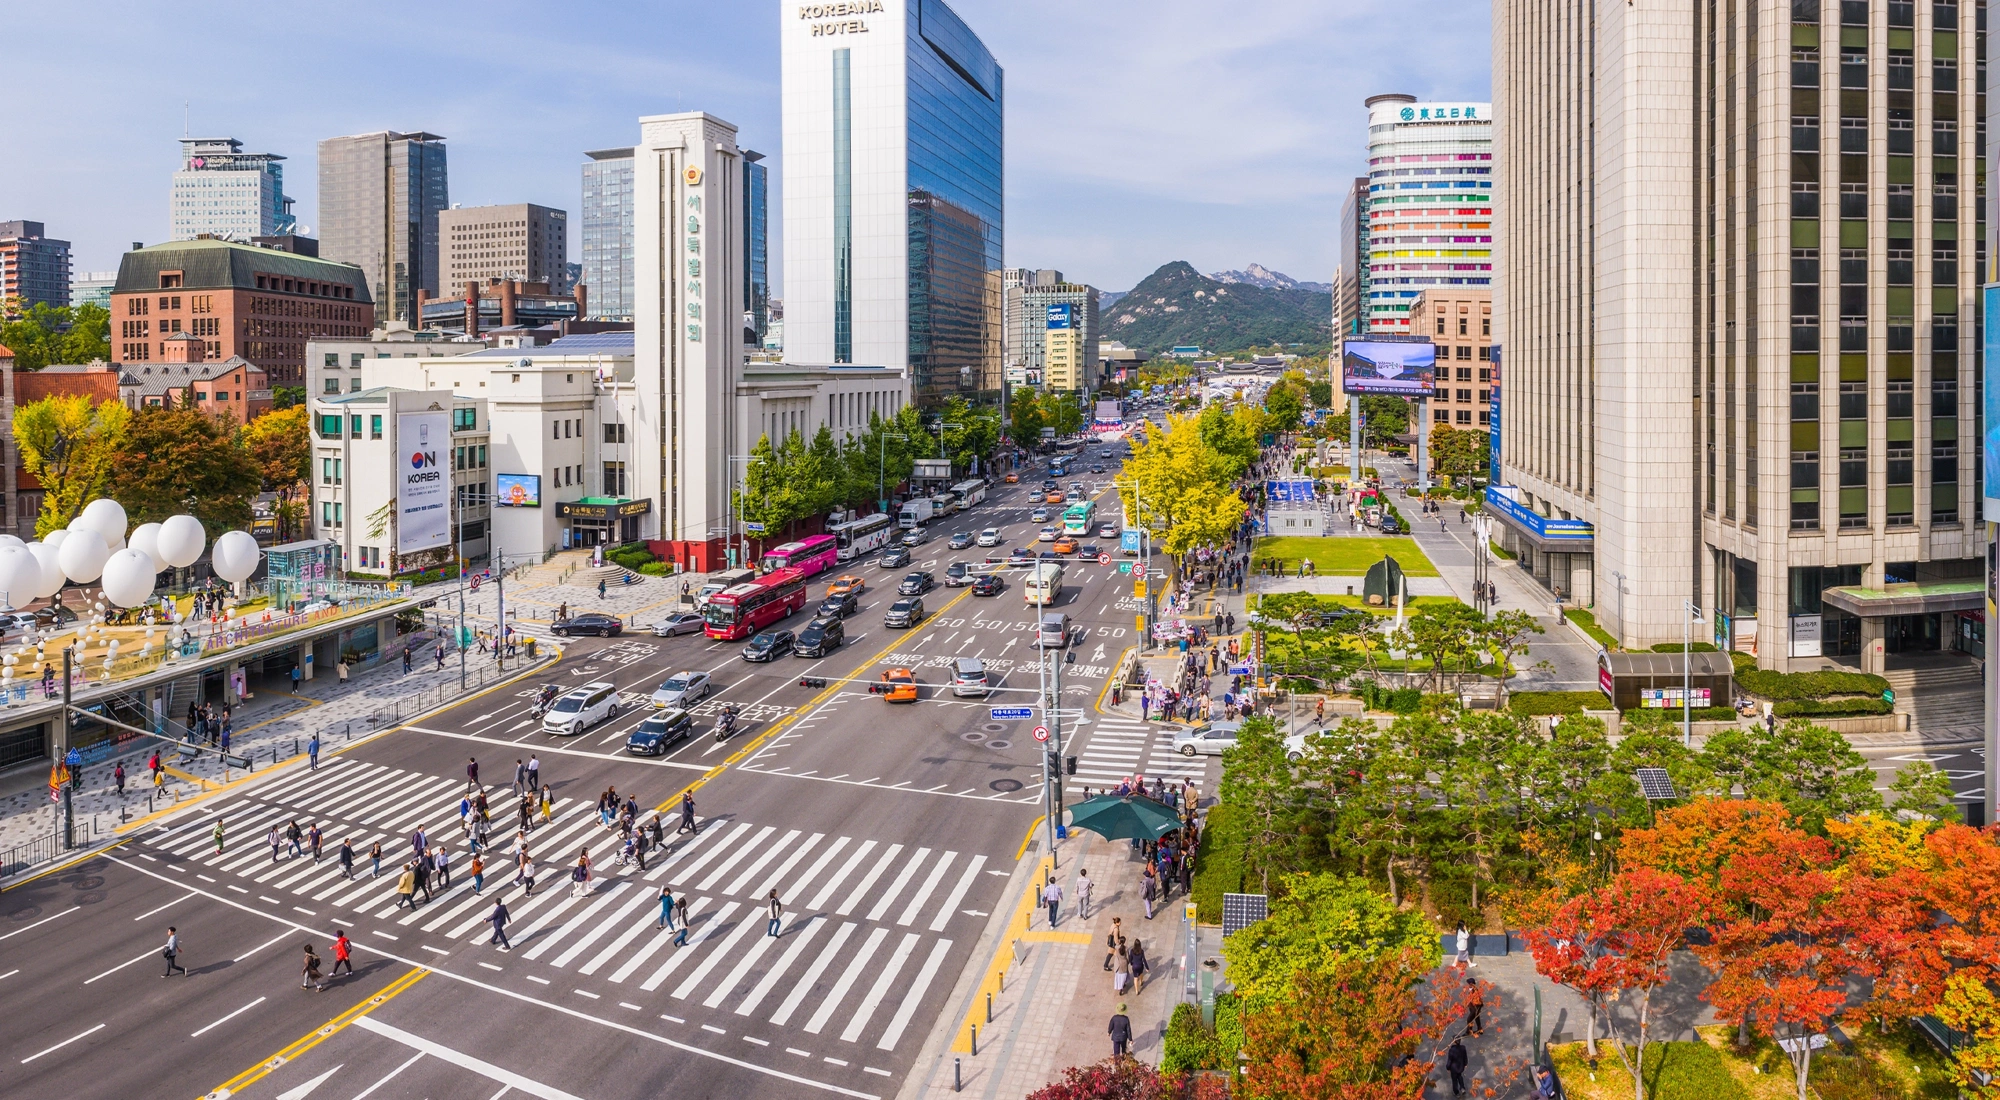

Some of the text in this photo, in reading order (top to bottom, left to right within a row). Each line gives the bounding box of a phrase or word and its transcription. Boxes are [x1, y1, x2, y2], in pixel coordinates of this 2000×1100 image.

[799, 0, 884, 19] KOREANA
[811, 20, 869, 37] HOTEL
[687, 195, 701, 342] 서울특별시의회
[1048, 313, 1068, 322] Galaxy
[408, 471, 440, 484] KOREA
[181, 641, 200, 658] OF
[206, 612, 309, 651] ARCHITECTURE
[313, 605, 338, 621] AND
[342, 589, 401, 614] URBANISM
[934, 617, 966, 628] 50
[972, 619, 1003, 630] 50
[1013, 621, 1039, 632] 50
[1097, 626, 1127, 638] 50
[1068, 664, 1110, 679] 청계천
